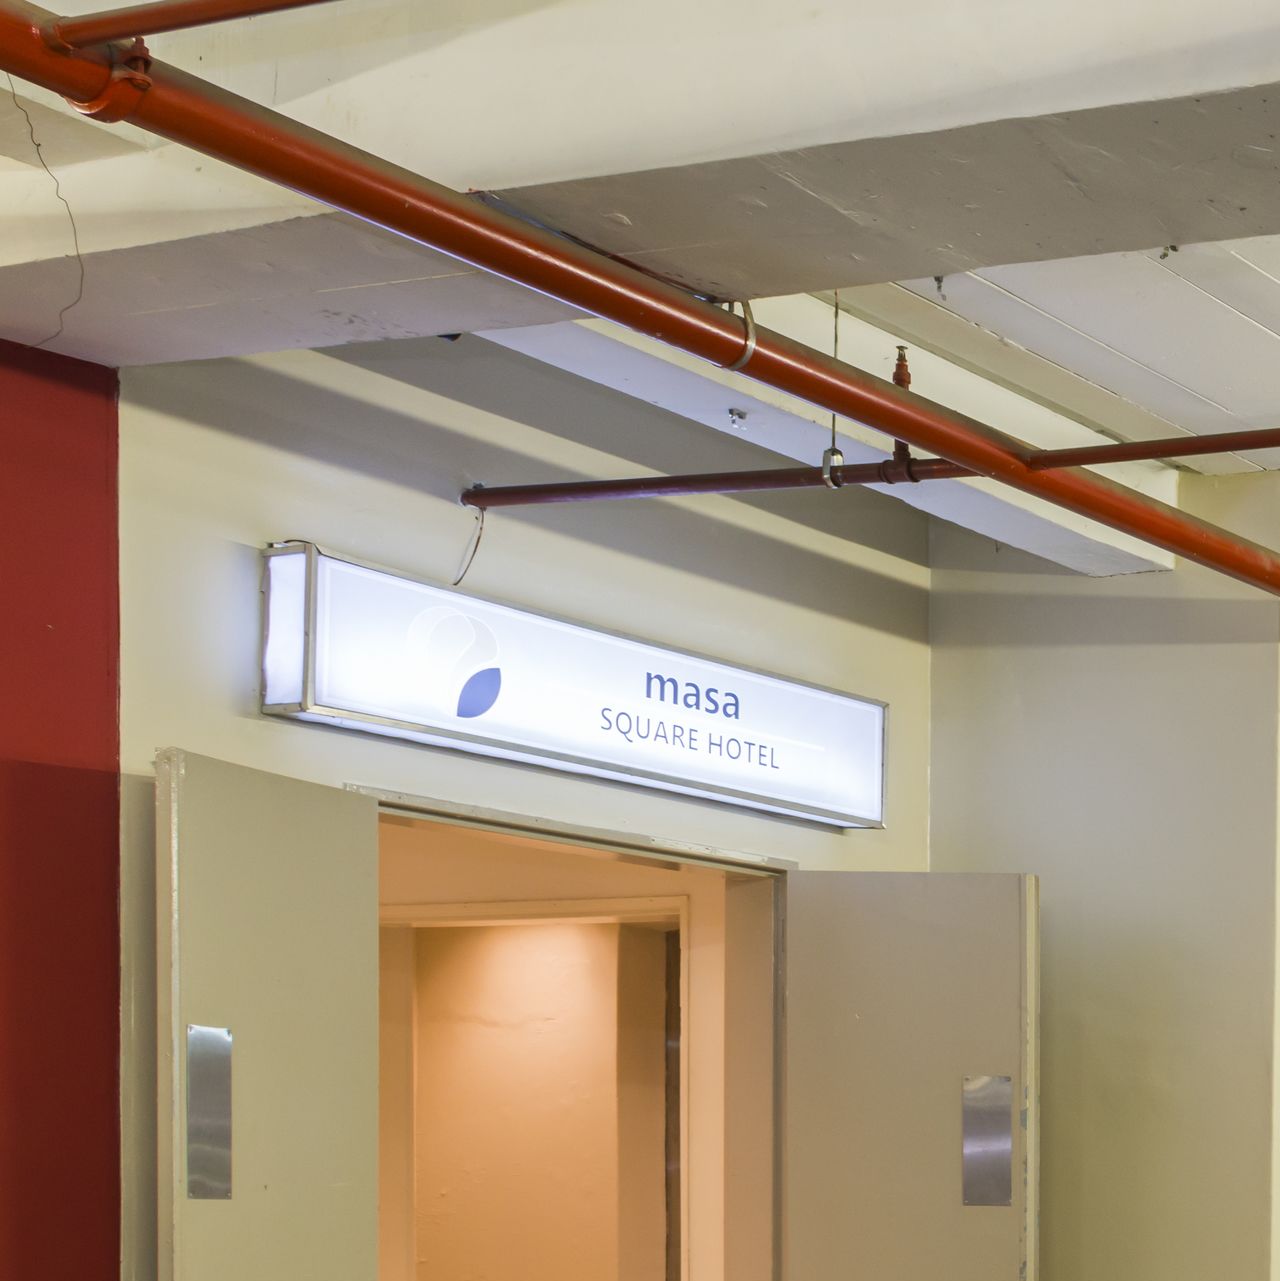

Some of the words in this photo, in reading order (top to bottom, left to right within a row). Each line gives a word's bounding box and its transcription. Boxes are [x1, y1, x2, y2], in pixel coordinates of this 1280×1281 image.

[645, 671, 740, 720] masa
[600, 707, 699, 751] SQUARE
[708, 732, 780, 770] HOTEL
